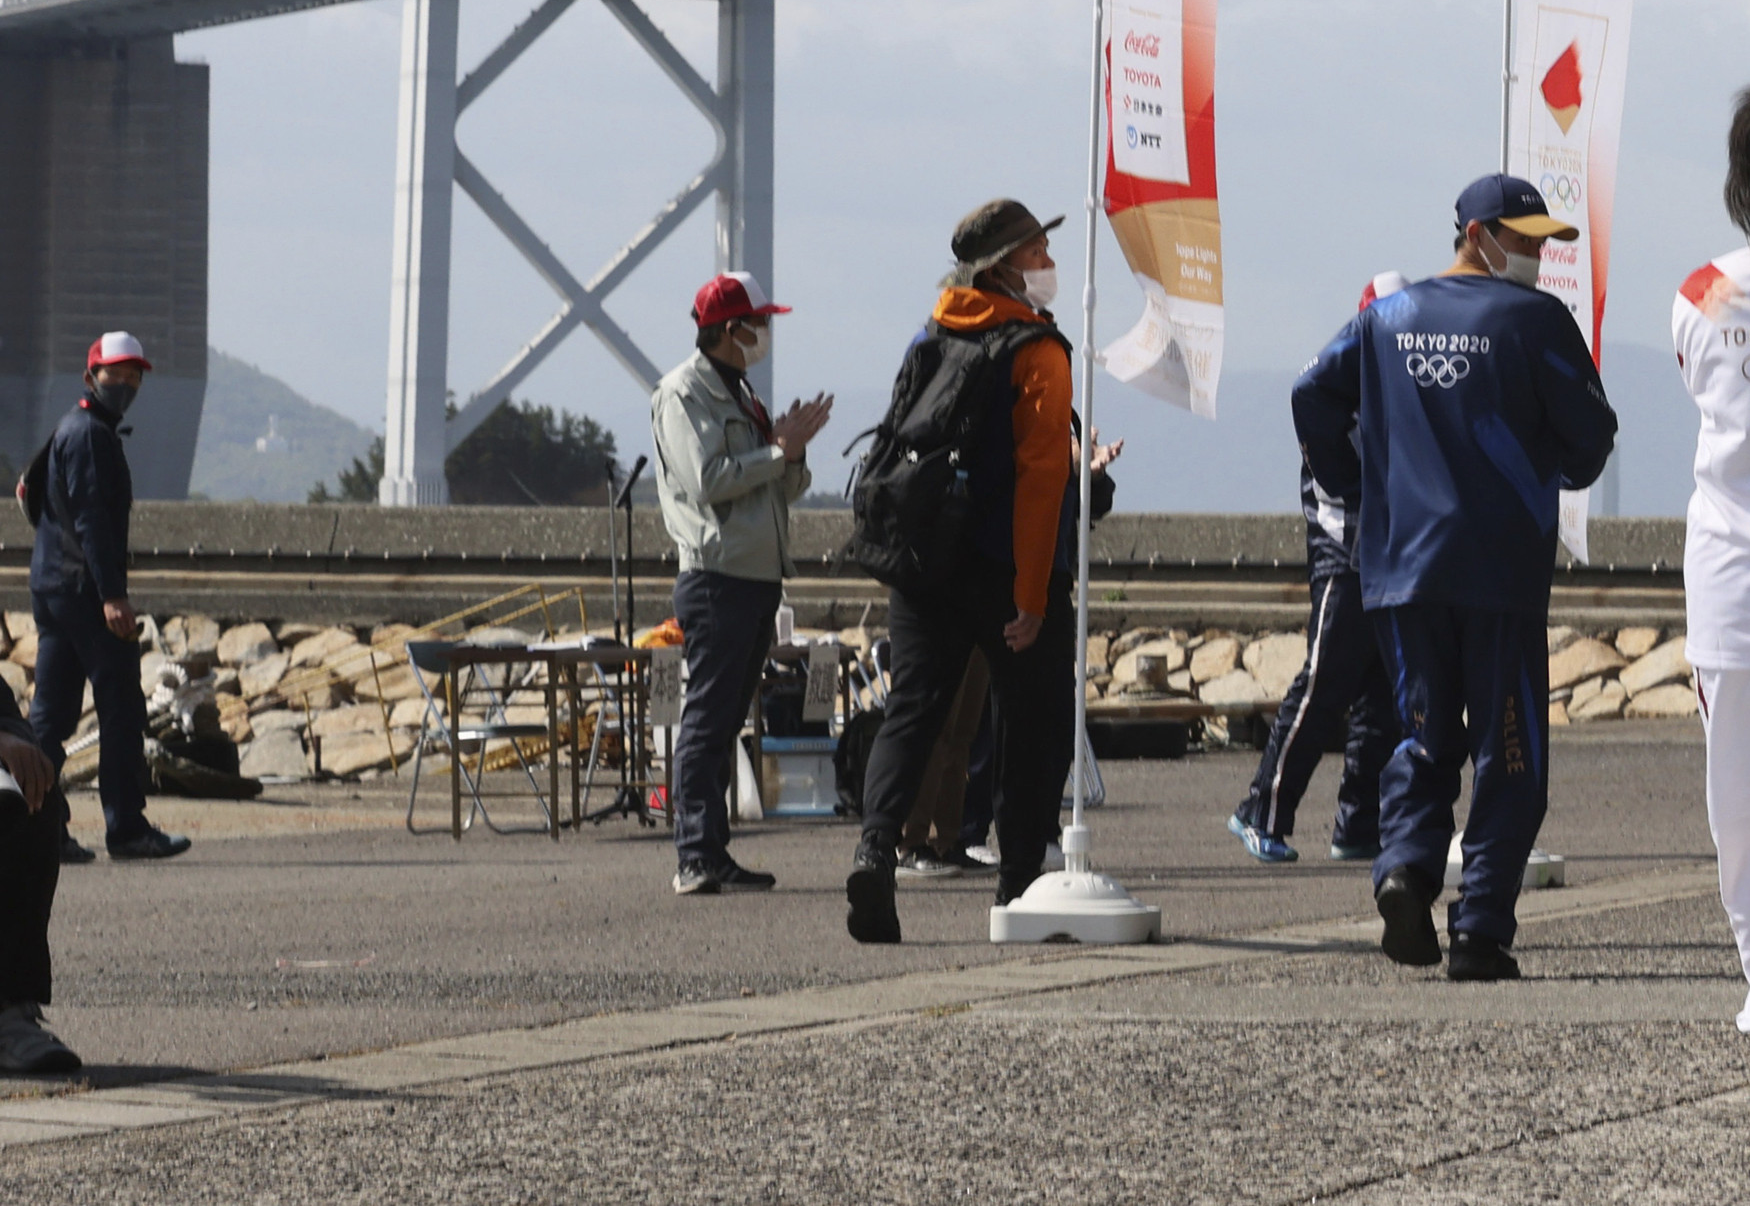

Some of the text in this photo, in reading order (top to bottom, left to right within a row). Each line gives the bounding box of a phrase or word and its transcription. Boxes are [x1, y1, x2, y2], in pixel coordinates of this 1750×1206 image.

[1123, 66, 1163, 90] TOYOTA
[1140, 131, 1162, 150] NTT
[1195, 243, 1218, 265] Lights
[1180, 262, 1213, 286] Our Way
[1395, 332, 1490, 354] TOKYO 2020
[1503, 695, 1526, 775] POLICE
